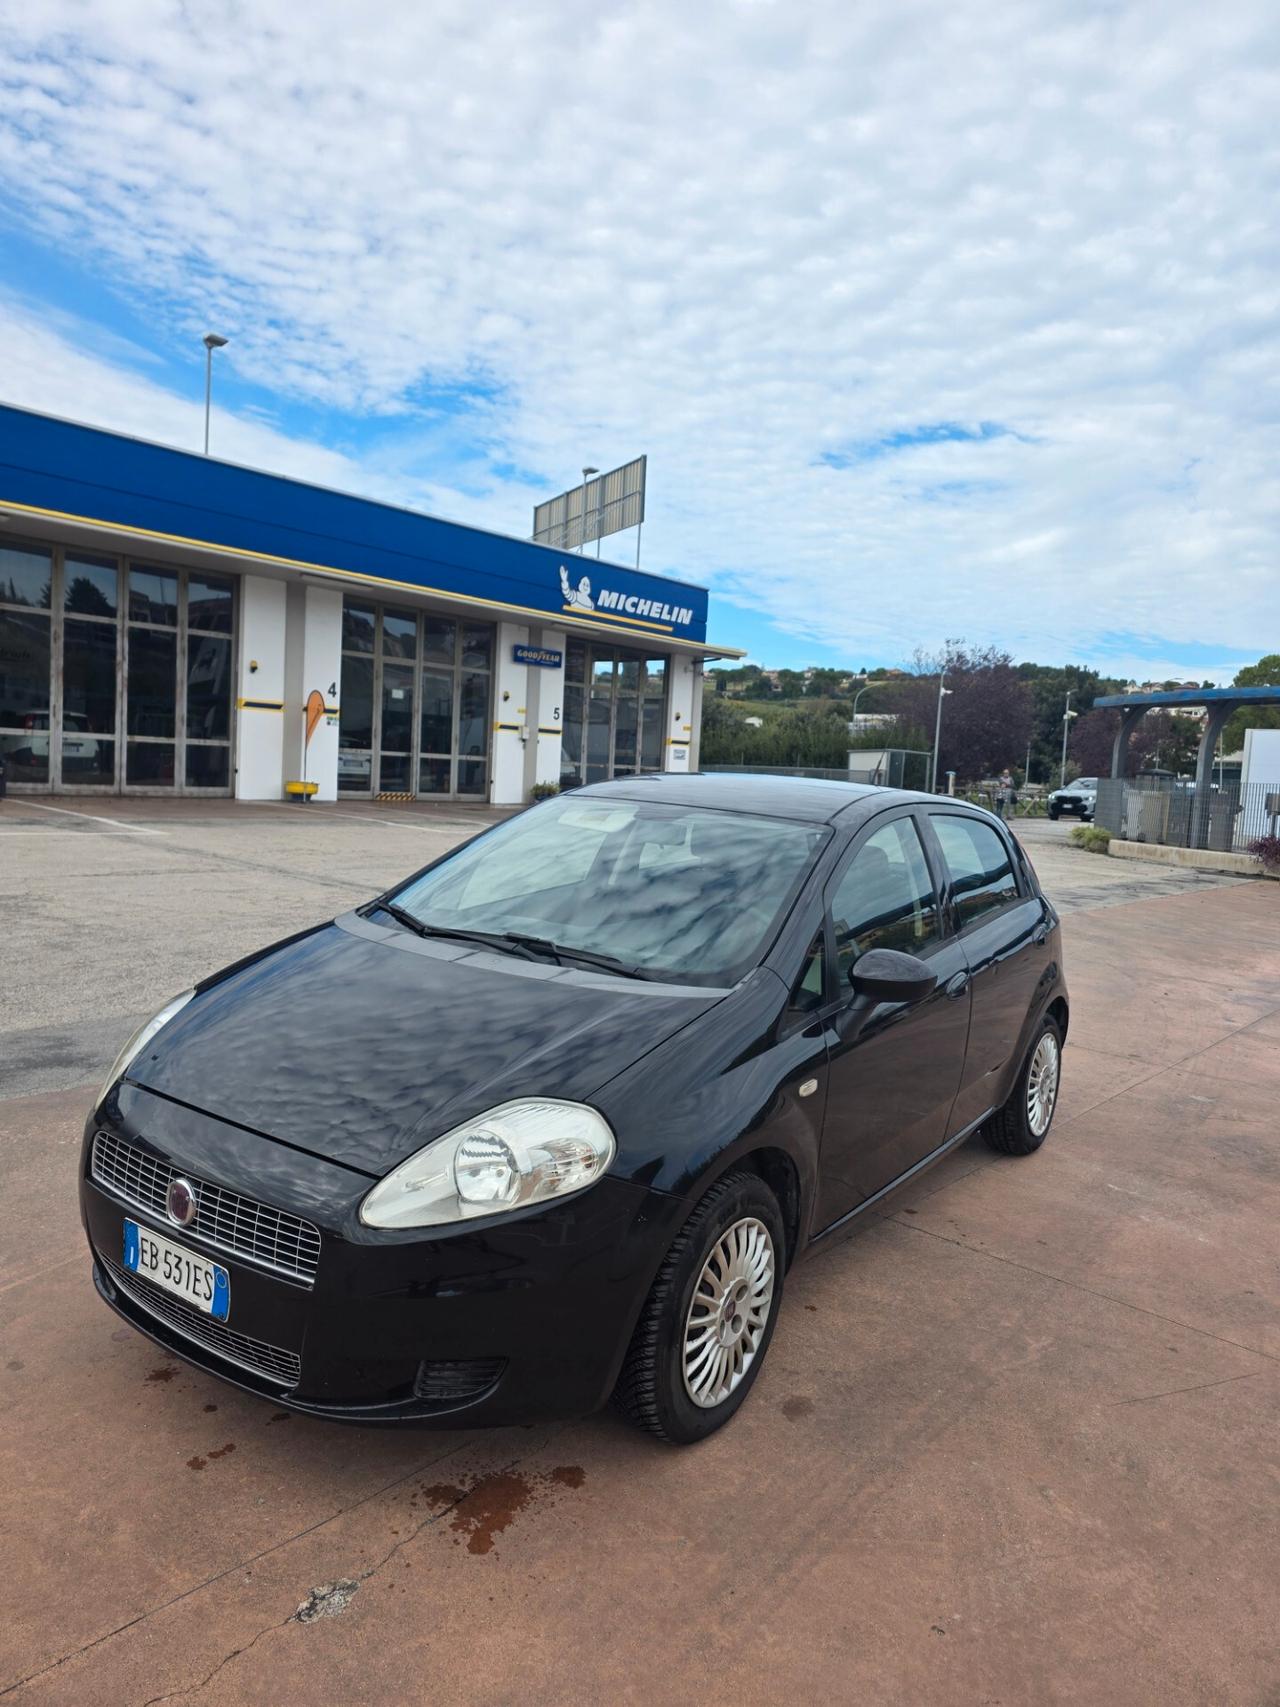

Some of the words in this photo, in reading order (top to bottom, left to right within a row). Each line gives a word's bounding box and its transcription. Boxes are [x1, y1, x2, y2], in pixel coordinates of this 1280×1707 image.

[597, 589, 693, 625] MICHELIN
[517, 649, 560, 662] GOODYEAR
[328, 681, 337, 698] 4
[553, 707, 560, 720] 5
[140, 1237, 159, 1271] EB
[163, 1251, 214, 1301] 531ES
